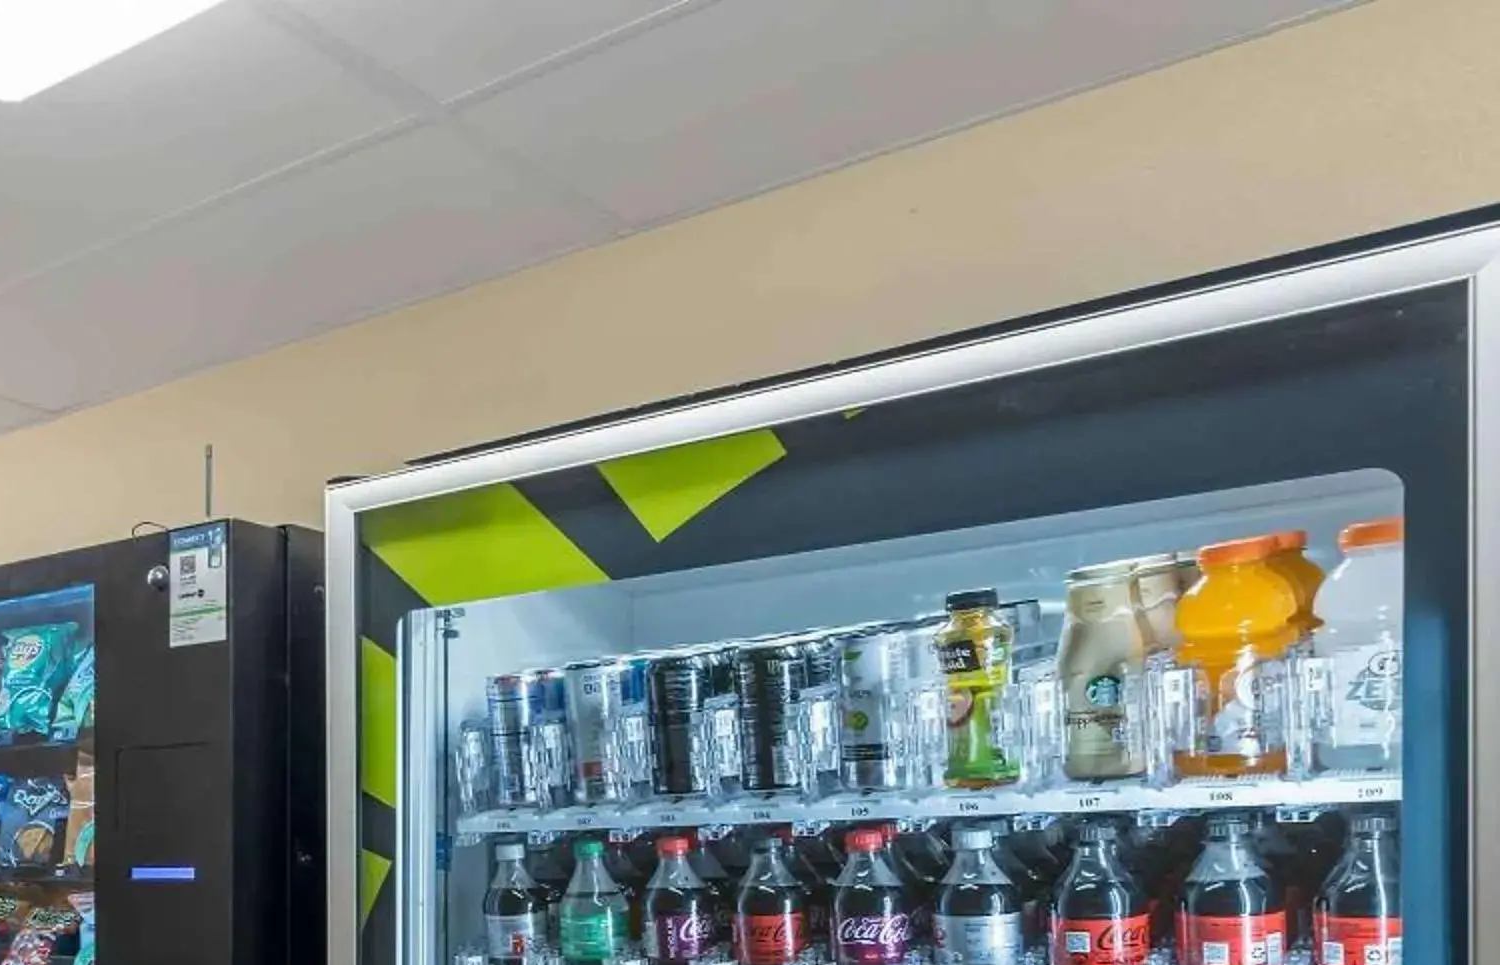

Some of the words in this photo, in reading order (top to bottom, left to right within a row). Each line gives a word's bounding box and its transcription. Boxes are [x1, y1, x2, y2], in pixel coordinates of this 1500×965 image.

[1208, 791, 1234, 802] 108
[958, 802, 980, 813] 106
[1077, 797, 1101, 809] 107
[849, 807, 870, 818] 105
